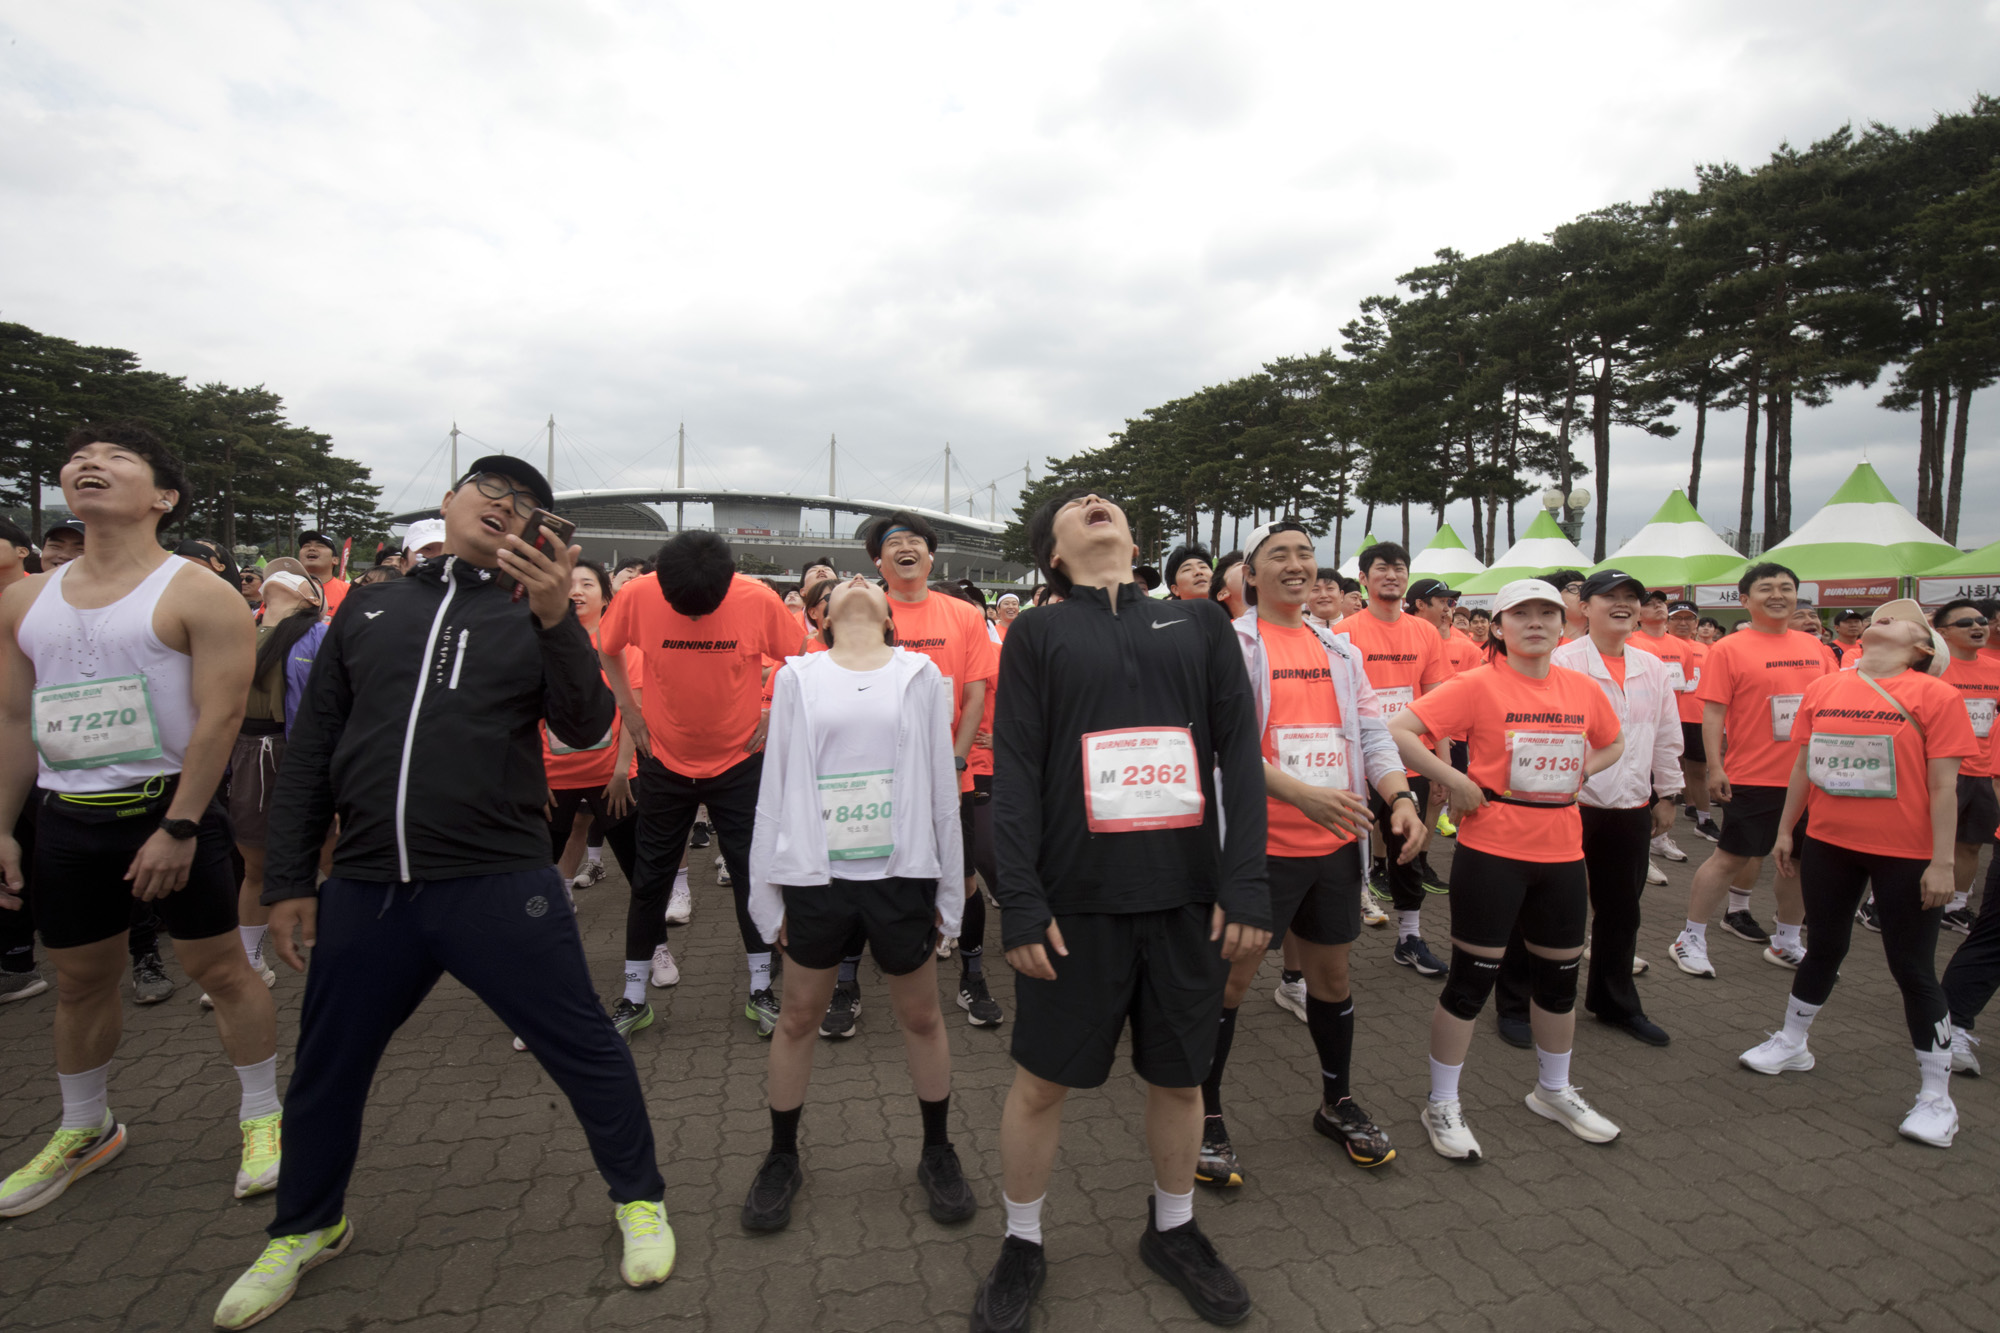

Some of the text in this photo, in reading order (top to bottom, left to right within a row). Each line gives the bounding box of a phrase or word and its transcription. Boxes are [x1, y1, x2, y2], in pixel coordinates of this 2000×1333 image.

[1823, 586, 1891, 596] BURNING RUN
[662, 639, 738, 650] BURNING RUN
[925, 638, 947, 647] RUN
[1366, 654, 1418, 662] BURNING RUN
[1766, 660, 1804, 669] BURNING
[1272, 668, 1320, 680] BURNING
[118, 684, 138, 692] 7km
[41, 690, 81, 703] BURNING
[82, 687, 103, 697] RUN
[47, 707, 137, 733] M 7270
[1505, 712, 1585, 725] BURNING RUN
[1815, 709, 1907, 723] BURNING RUN
[1282, 732, 1314, 740] BURNING
[1095, 739, 1139, 751] BURNING
[1140, 738, 1160, 747] RUN
[1287, 752, 1344, 767] M 1520
[1519, 756, 1580, 772] W 3136
[1815, 756, 1881, 771] W 8108
[1100, 764, 1187, 786] M 2362
[835, 801, 893, 824] 8430
